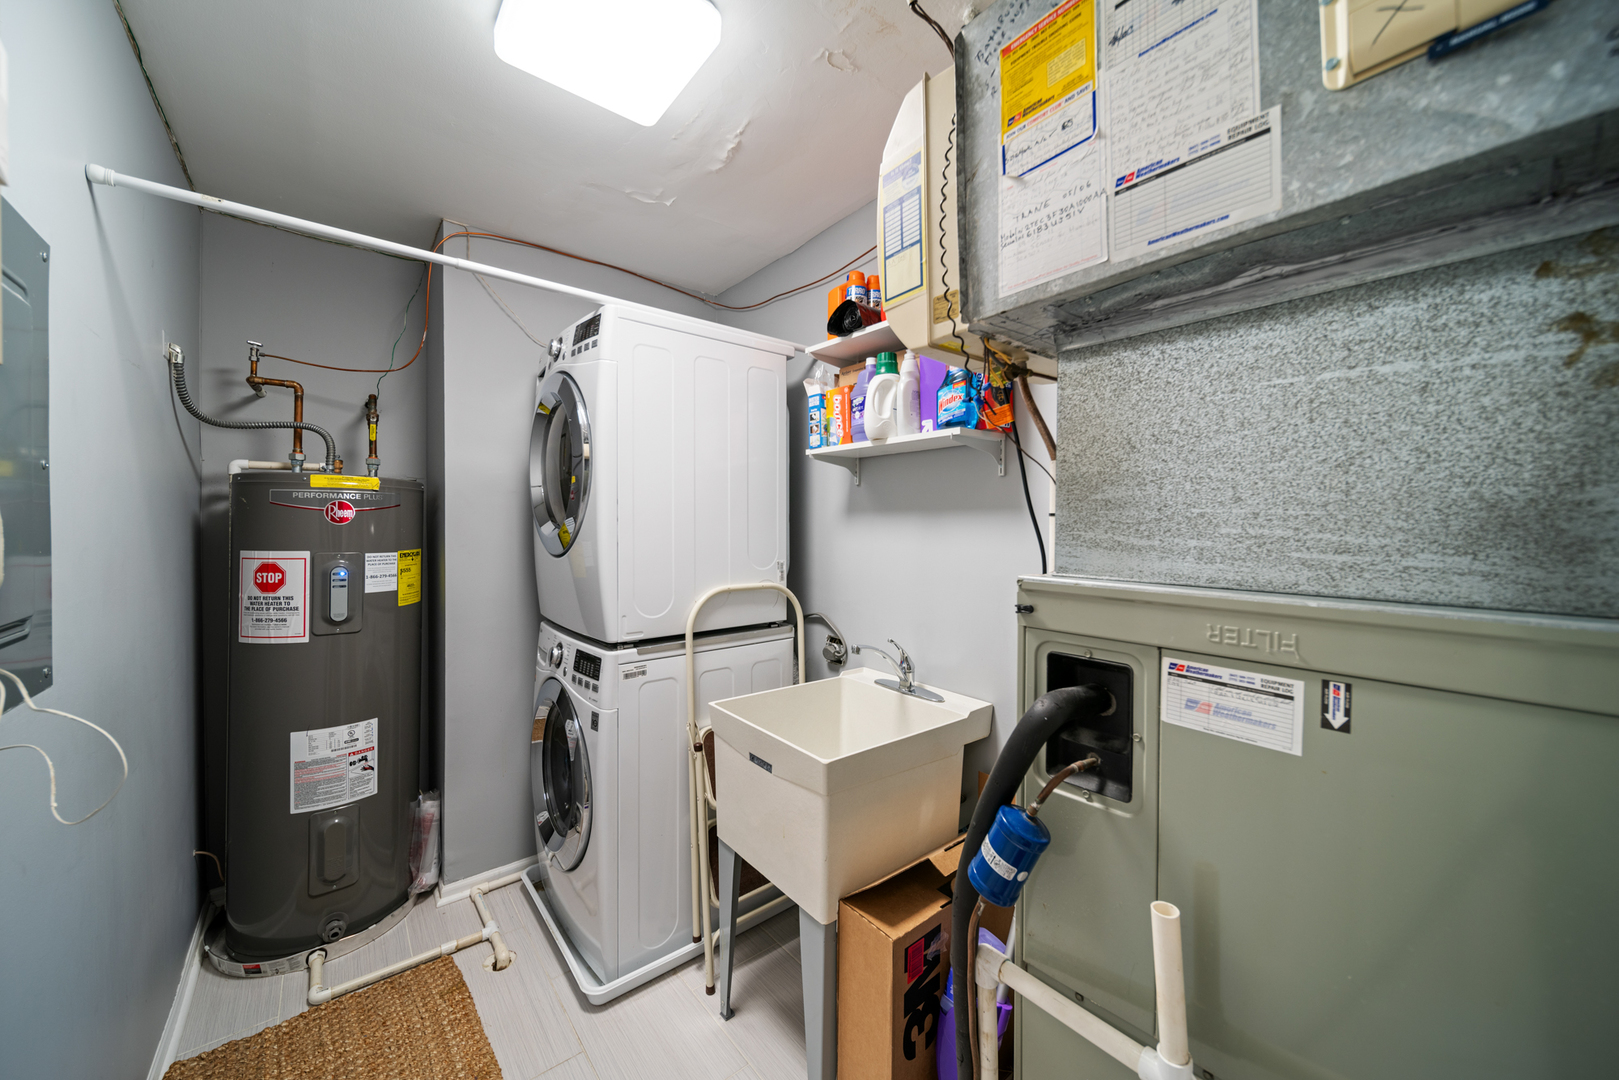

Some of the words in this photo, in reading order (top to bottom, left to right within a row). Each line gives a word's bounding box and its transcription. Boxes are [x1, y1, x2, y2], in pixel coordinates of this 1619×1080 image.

[1027, 110, 1049, 127] COMFORT
[1064, 93, 1076, 104] AND
[1227, 112, 1270, 135] EQUIPMENT
[1228, 127, 1253, 141] REPAIR
[1254, 120, 1270, 131] LOG
[1135, 157, 1180, 179] Weathermakers
[1136, 159, 1163, 175] American
[1147, 214, 1230, 246] AmericanWeathermakers.com
[938, 394, 965, 416] Windex
[833, 394, 844, 438] bounce
[292, 492, 362, 500] PERFORMANCE
[328, 500, 353, 521] Rheem
[256, 572, 282, 583] STOP
[1206, 623, 1299, 660] FILTER
[1185, 669, 1223, 680] Weathermakers
[1187, 664, 1209, 673] American
[1260, 678, 1295, 688] EQUIPMENT
[1261, 683, 1281, 691] REPAIR
[1281, 687, 1294, 695] LOG
[1212, 710, 1277, 730] Weathermakers
[1213, 702, 1253, 717] American
[903, 923, 941, 1060] 3M
